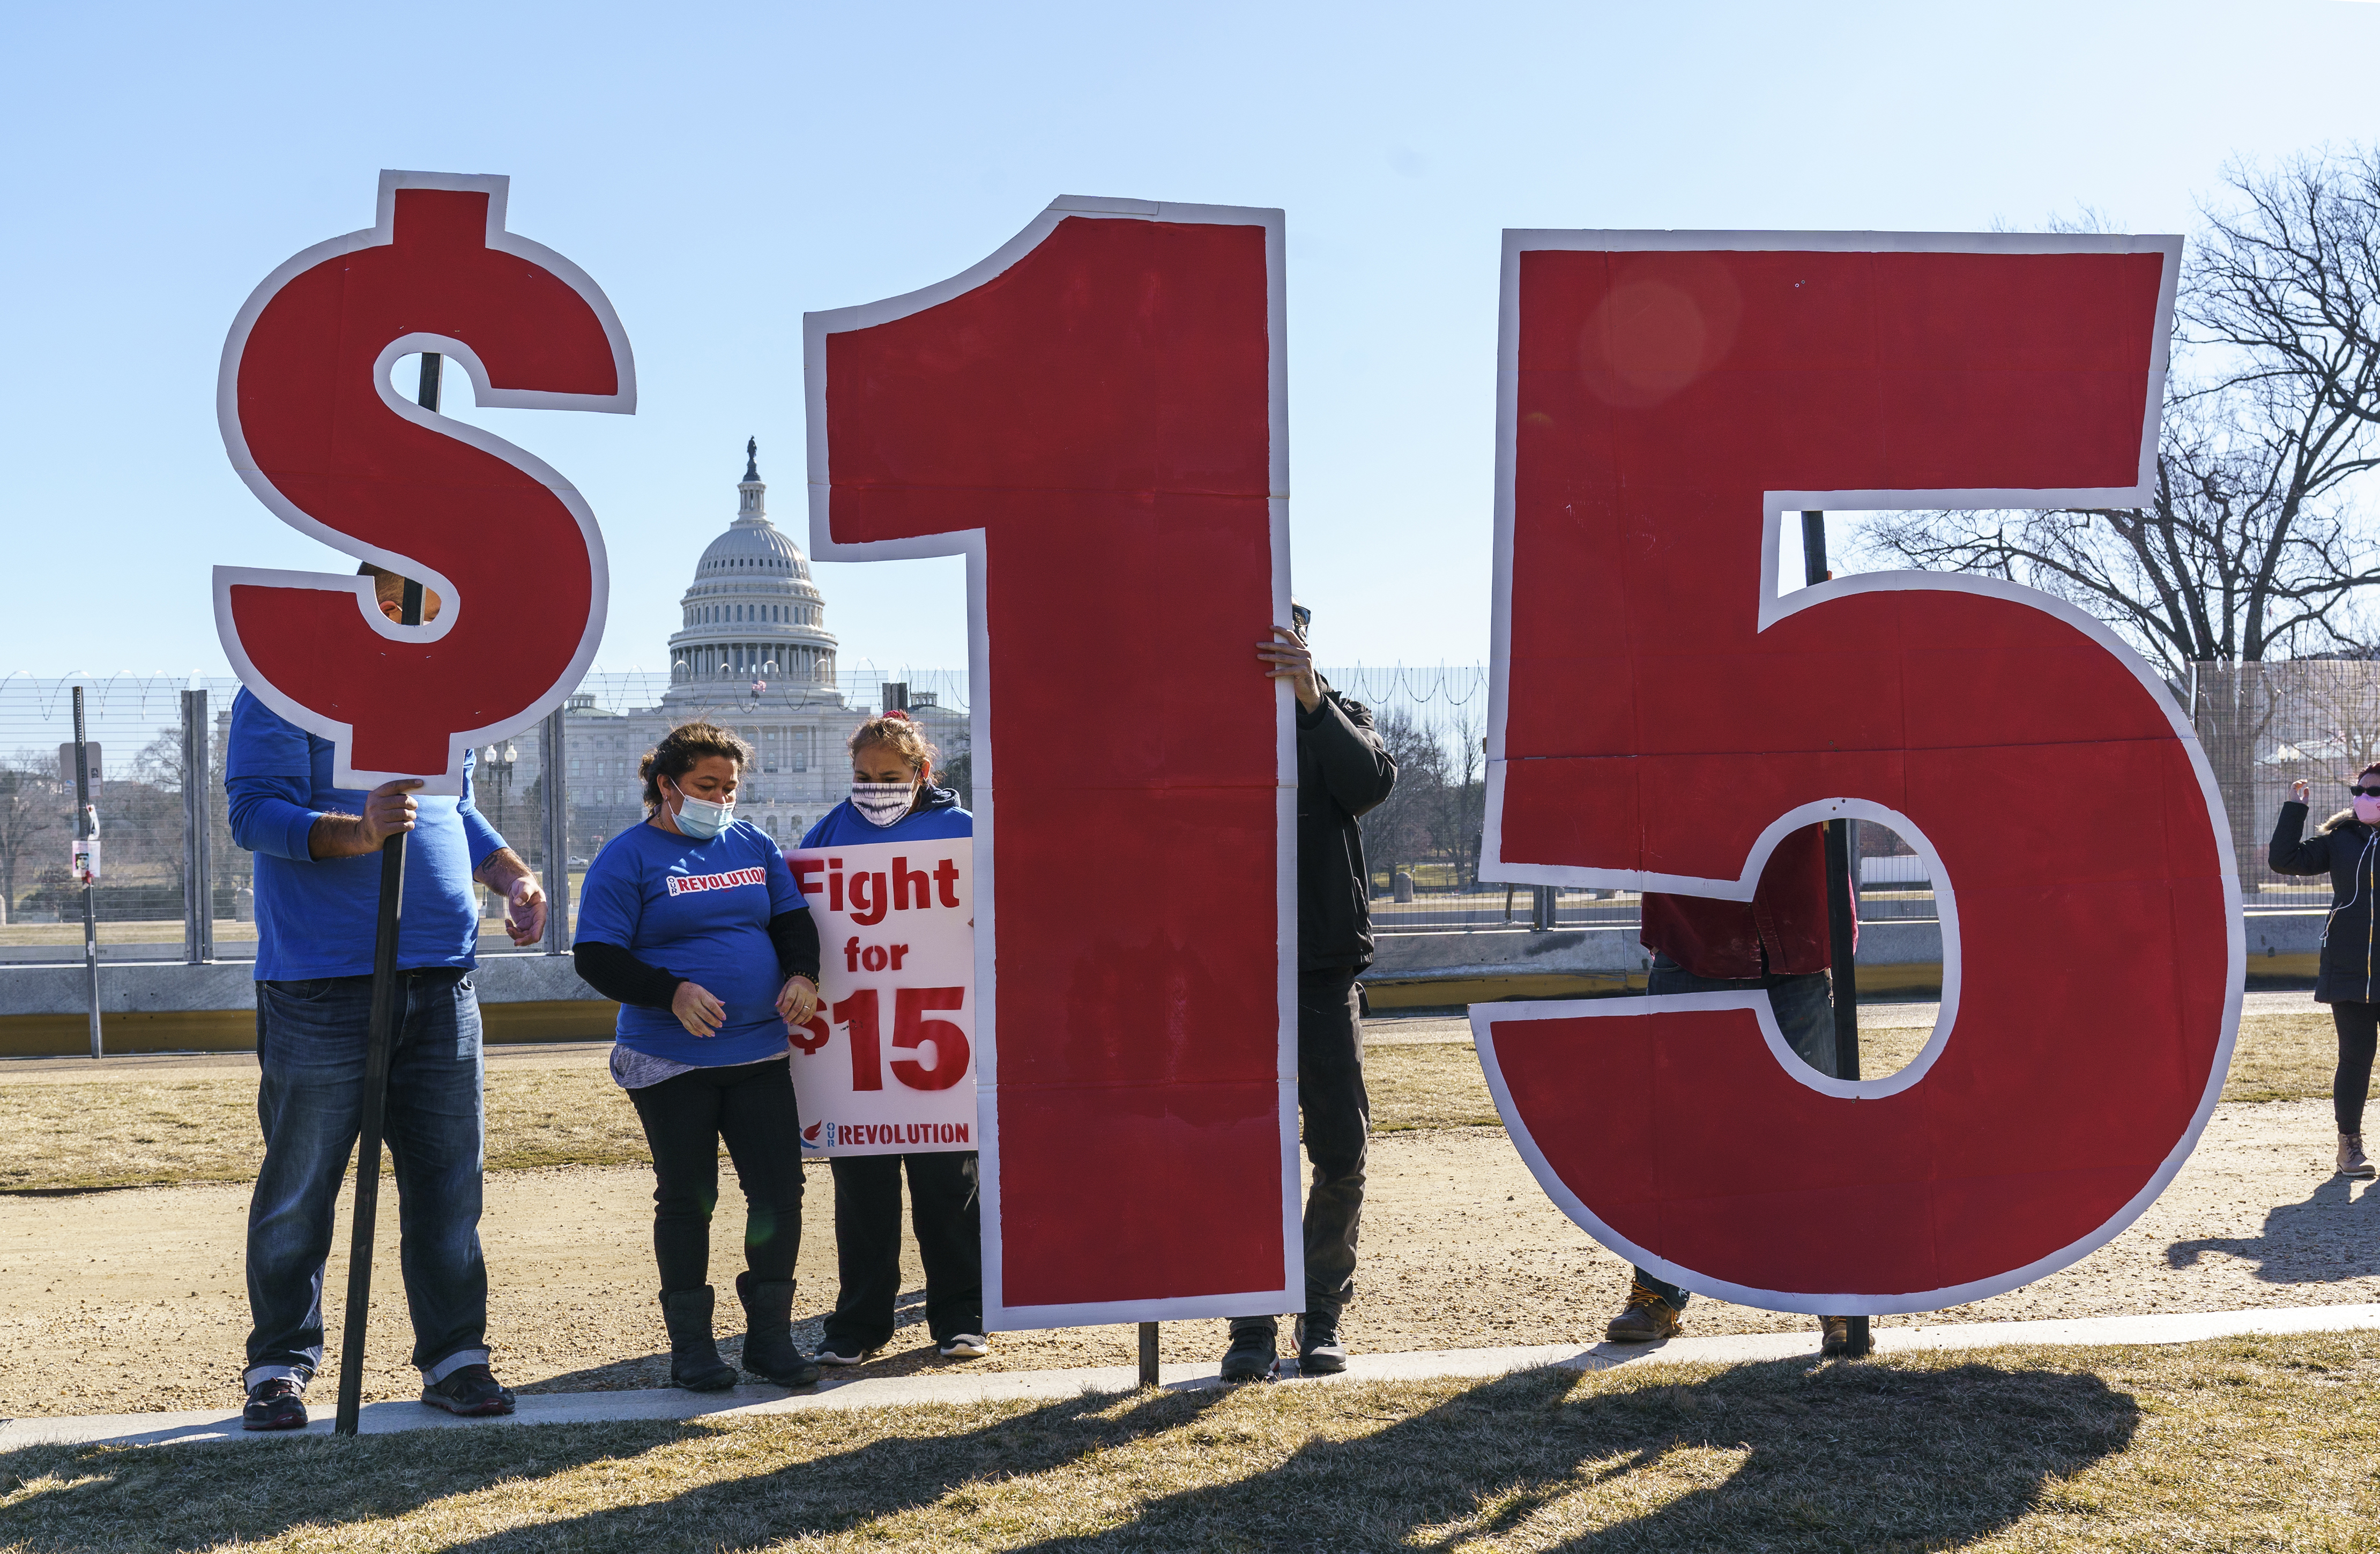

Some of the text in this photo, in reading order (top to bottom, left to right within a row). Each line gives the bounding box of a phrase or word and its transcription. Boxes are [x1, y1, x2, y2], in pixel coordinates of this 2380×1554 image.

[668, 868, 765, 894] OUR REVOLUTION
[787, 857, 960, 926] Fight
[844, 936, 909, 972] for
[827, 1122, 969, 1148] OUR REVOLUTION
